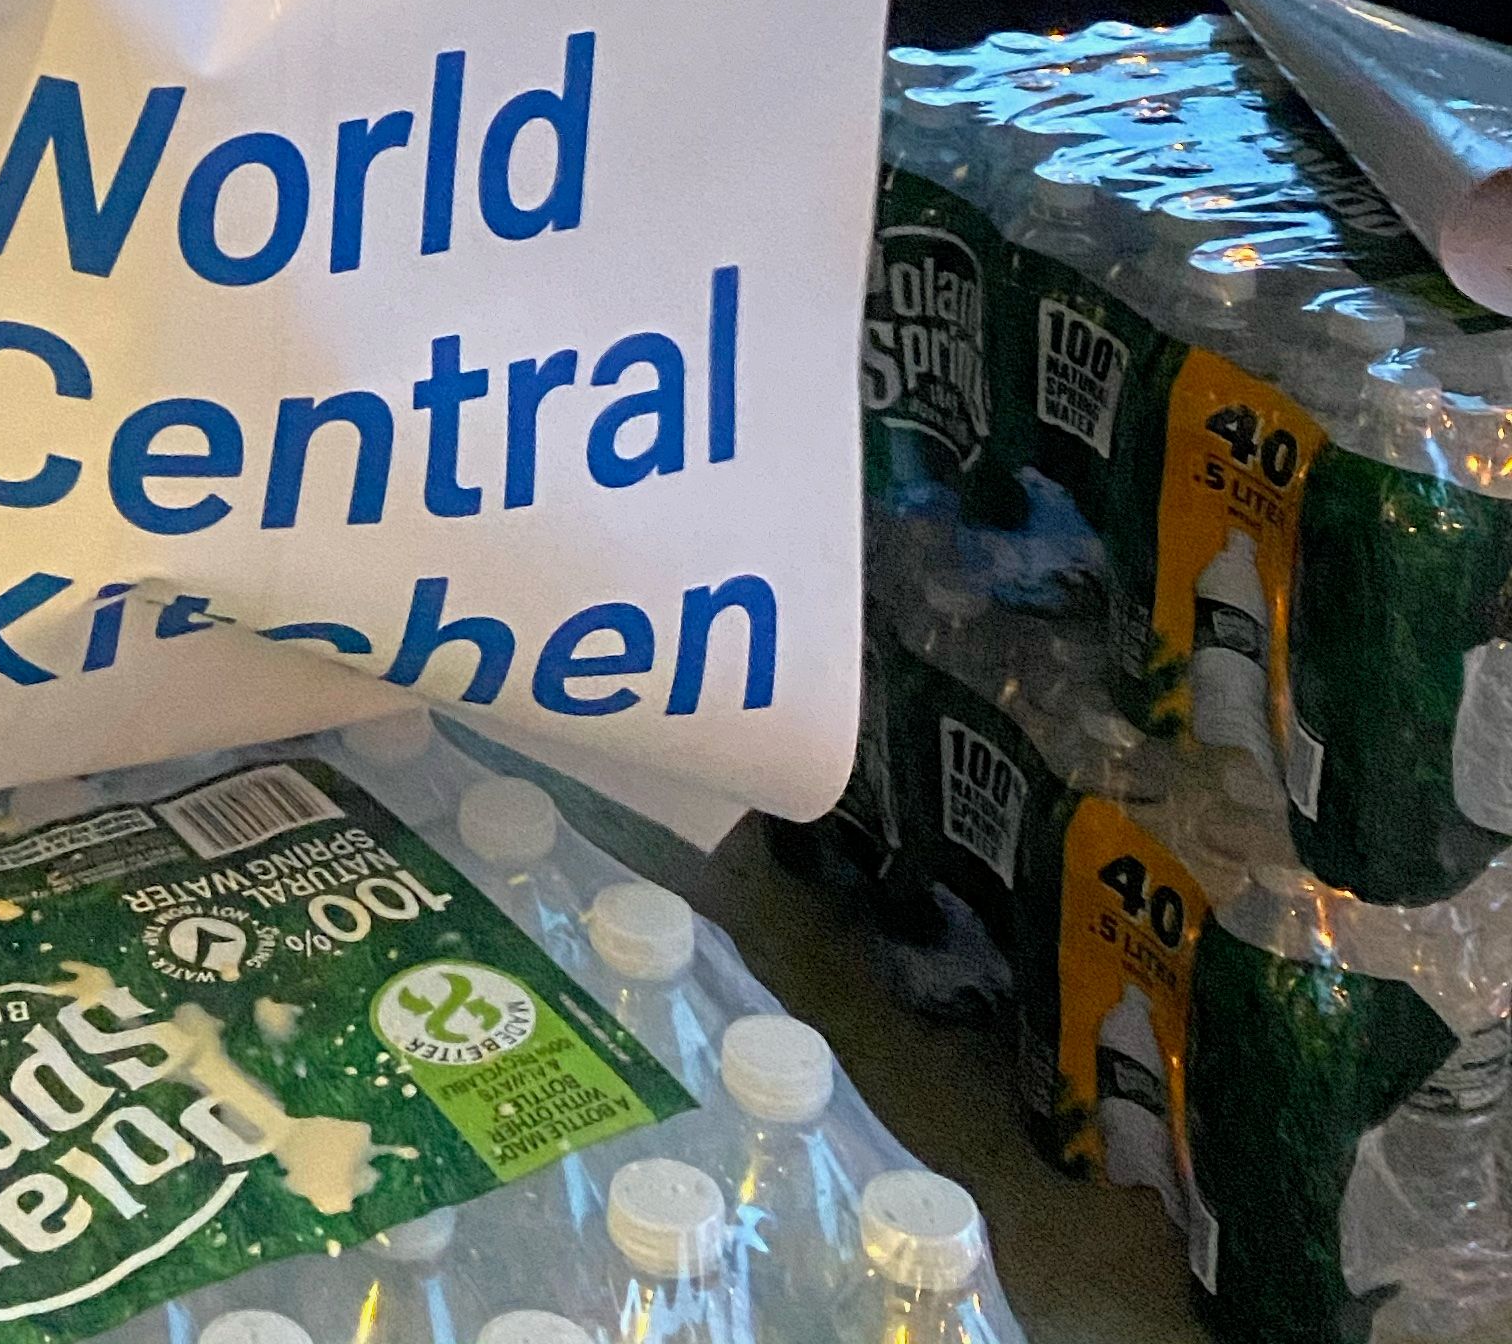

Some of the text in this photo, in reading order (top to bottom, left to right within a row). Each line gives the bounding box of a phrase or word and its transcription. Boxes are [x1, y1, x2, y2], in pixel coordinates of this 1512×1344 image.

[1205, 402, 1299, 489] 40
[121, 827, 375, 914] SPRING WATER
[241, 847, 399, 909] NATURAL
[212, 904, 248, 923] NOT
[284, 868, 452, 958] 100%
[1098, 854, 1185, 949] 40
[152, 957, 216, 984] WATER
[404, 1000, 534, 1063] MADE BETTER
[478, 1064, 546, 1102] ALWAYS
[614, 1094, 631, 1112] A
[487, 1086, 609, 1144] WITH OTHER
[545, 1103, 616, 1146] BOTTLE
